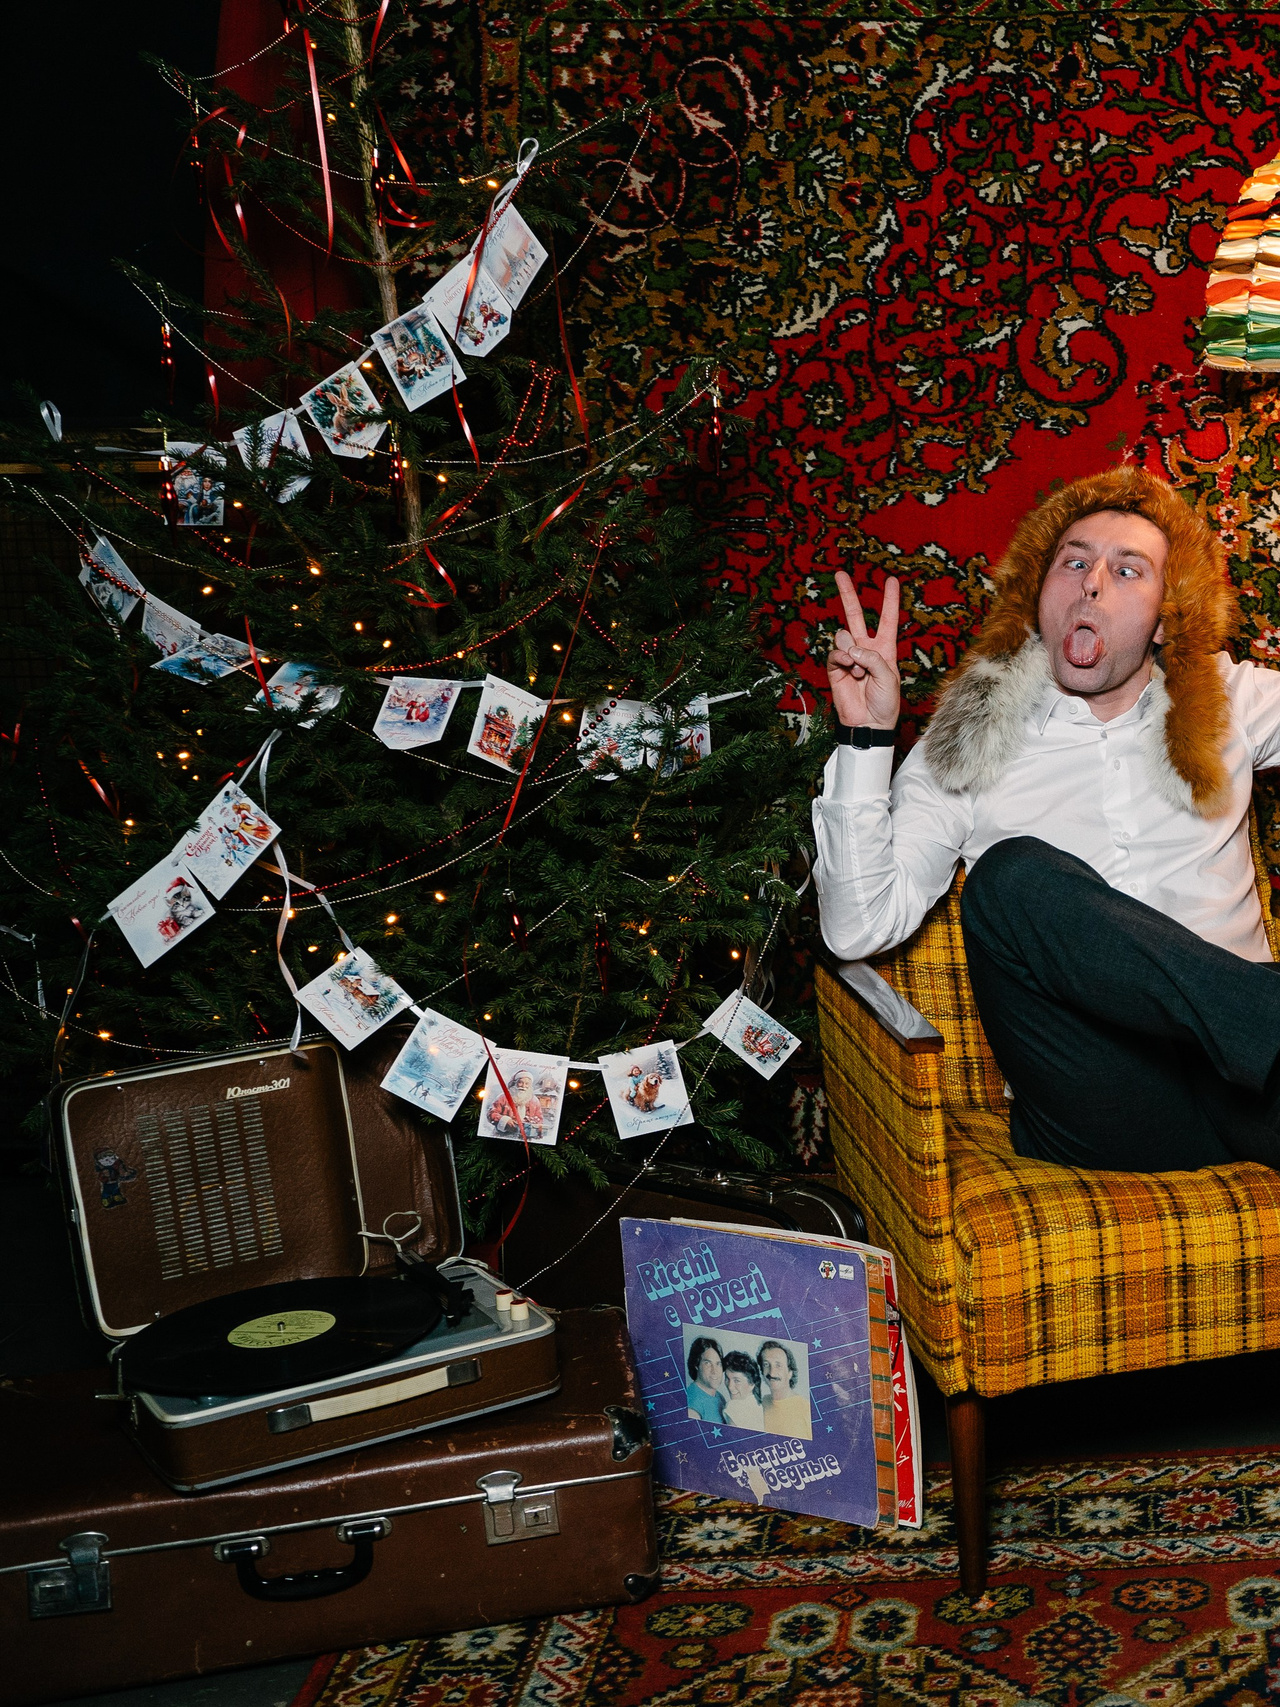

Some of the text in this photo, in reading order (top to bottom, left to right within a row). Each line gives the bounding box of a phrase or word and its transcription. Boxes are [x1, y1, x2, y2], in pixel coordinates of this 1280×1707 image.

[636, 1242, 721, 1302] Ricchi
[664, 1261, 772, 1328] e Poveri
[720, 1438, 807, 1478] Богатые
[763, 1454, 842, 1492] бедные
